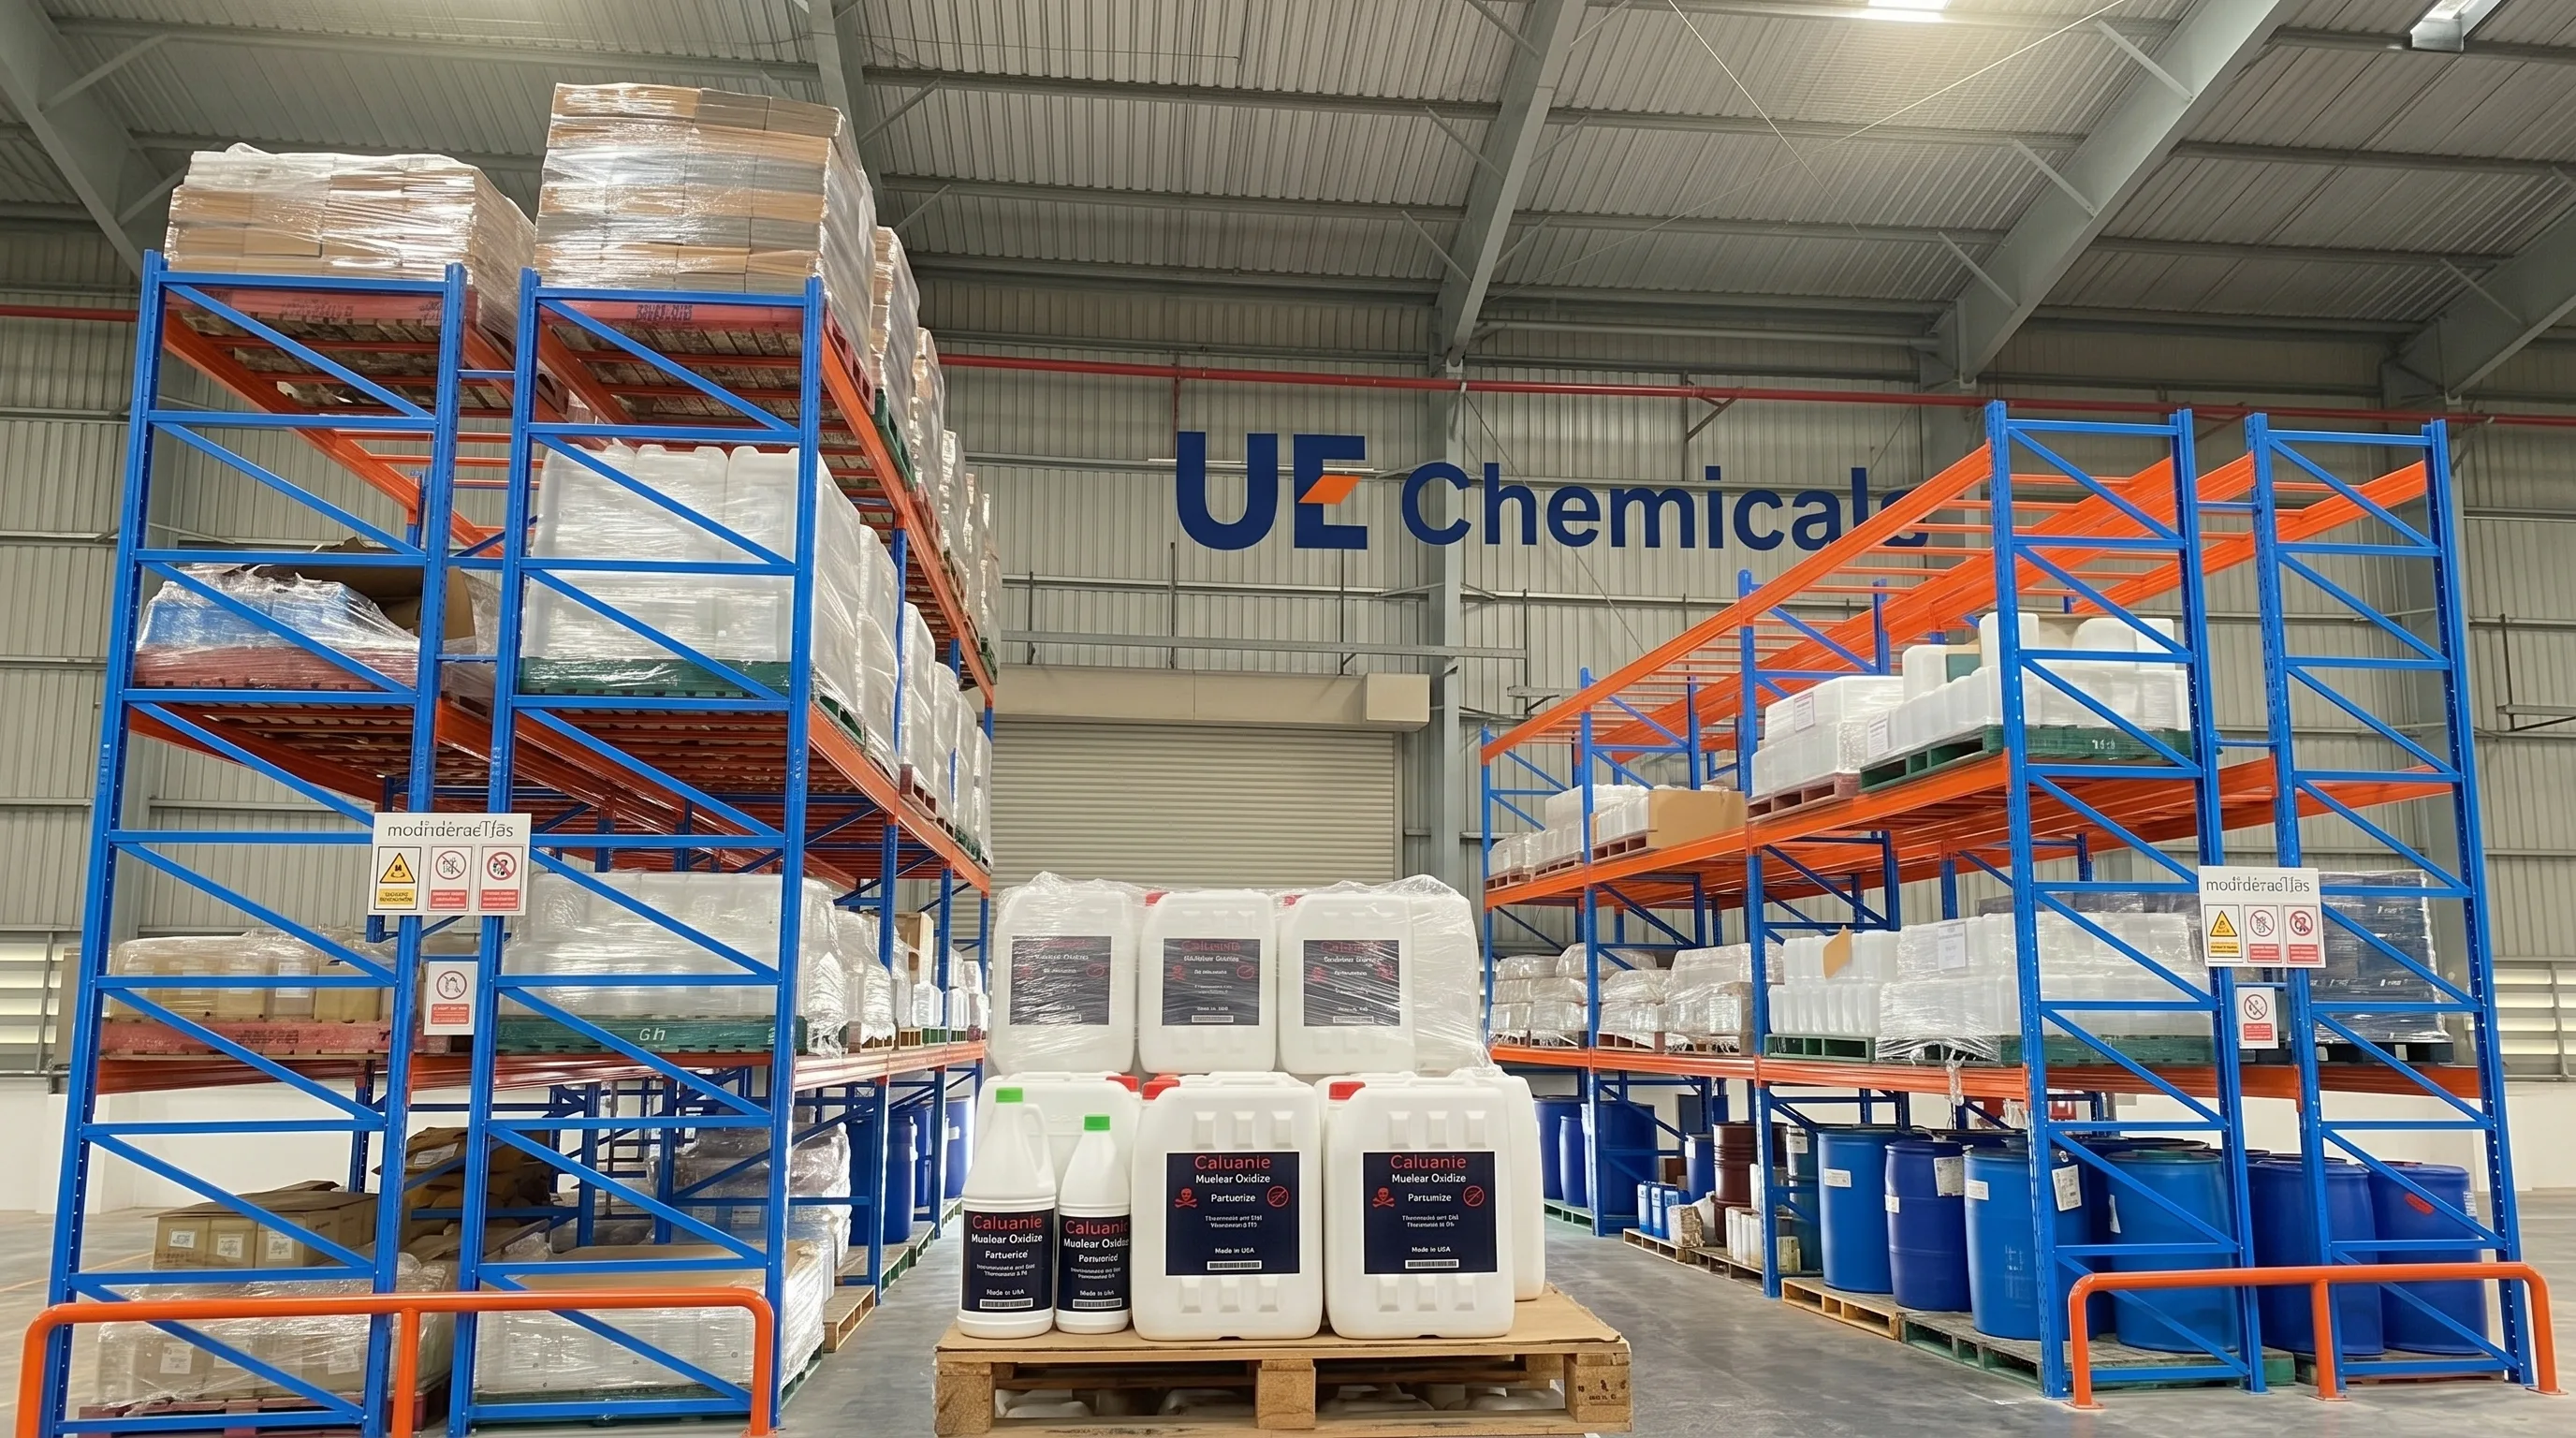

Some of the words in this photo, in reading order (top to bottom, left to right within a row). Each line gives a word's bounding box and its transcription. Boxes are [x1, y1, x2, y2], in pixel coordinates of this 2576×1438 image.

[1177, 432, 1368, 550] UE
[1194, 1155, 1271, 1169] Caluanie
[1390, 1154, 1467, 1169] Caluanie
[1195, 1174, 1234, 1183] Muelear
[1236, 1173, 1271, 1183] Oxidize
[1392, 1174, 1429, 1183] Muelear
[1431, 1173, 1467, 1183] Oxidize
[972, 1214, 1043, 1231] Caluanie
[1009, 1233, 1043, 1244] Oxidize
